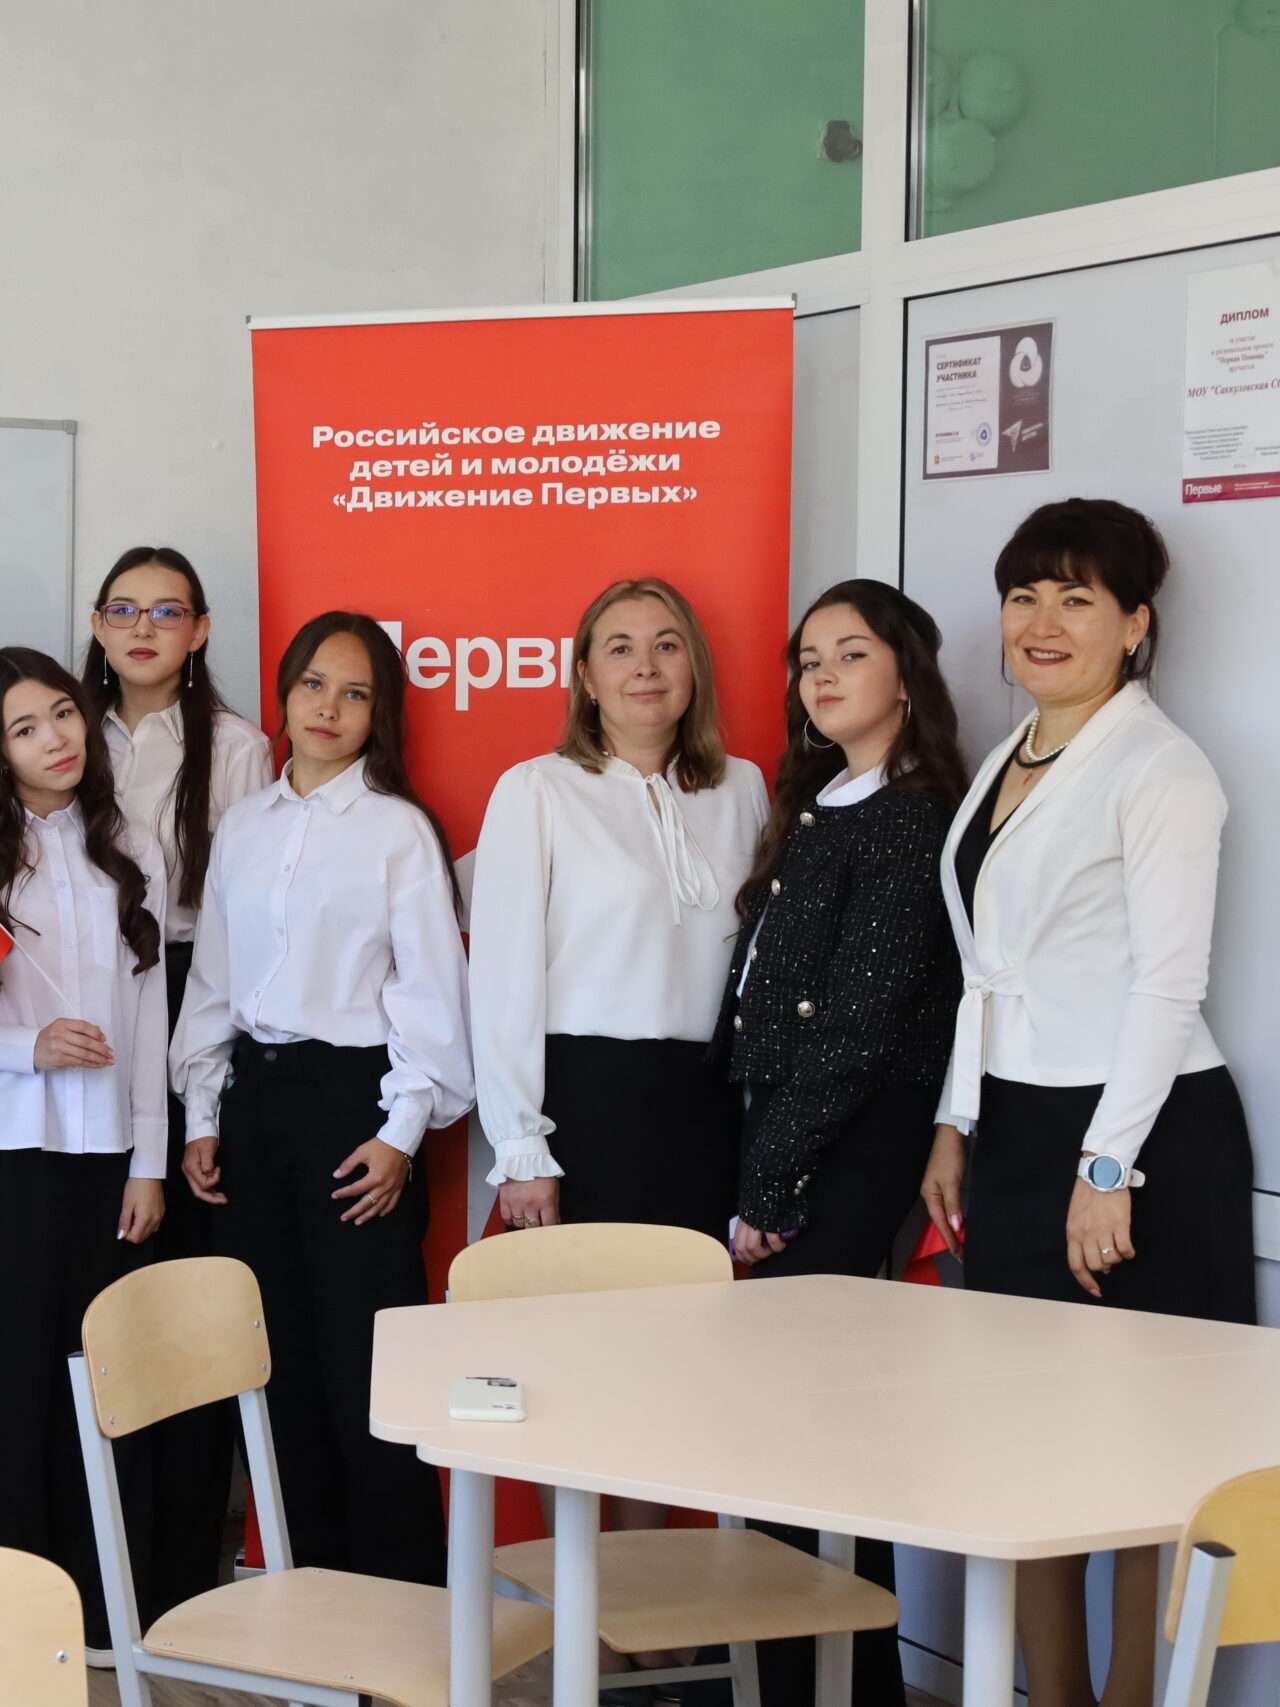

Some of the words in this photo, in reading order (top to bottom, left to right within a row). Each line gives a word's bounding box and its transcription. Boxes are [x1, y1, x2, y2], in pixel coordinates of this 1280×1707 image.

[1220, 307, 1270, 326] ДИПЛОМ
[936, 357, 982, 370] СЕРТИФИКАТ
[936, 371, 977, 383] УЧАСТНИКА
[313, 422, 526, 448] Российское
[532, 419, 721, 445] движение
[349, 453, 453, 481] детей
[461, 458, 483, 475] и
[491, 449, 681, 477] молодёжи
[333, 485, 534, 512] «Движение
[541, 482, 698, 510] Первых»
[1185, 482, 1223, 498] Первые
[376, 620, 574, 712] ерв
